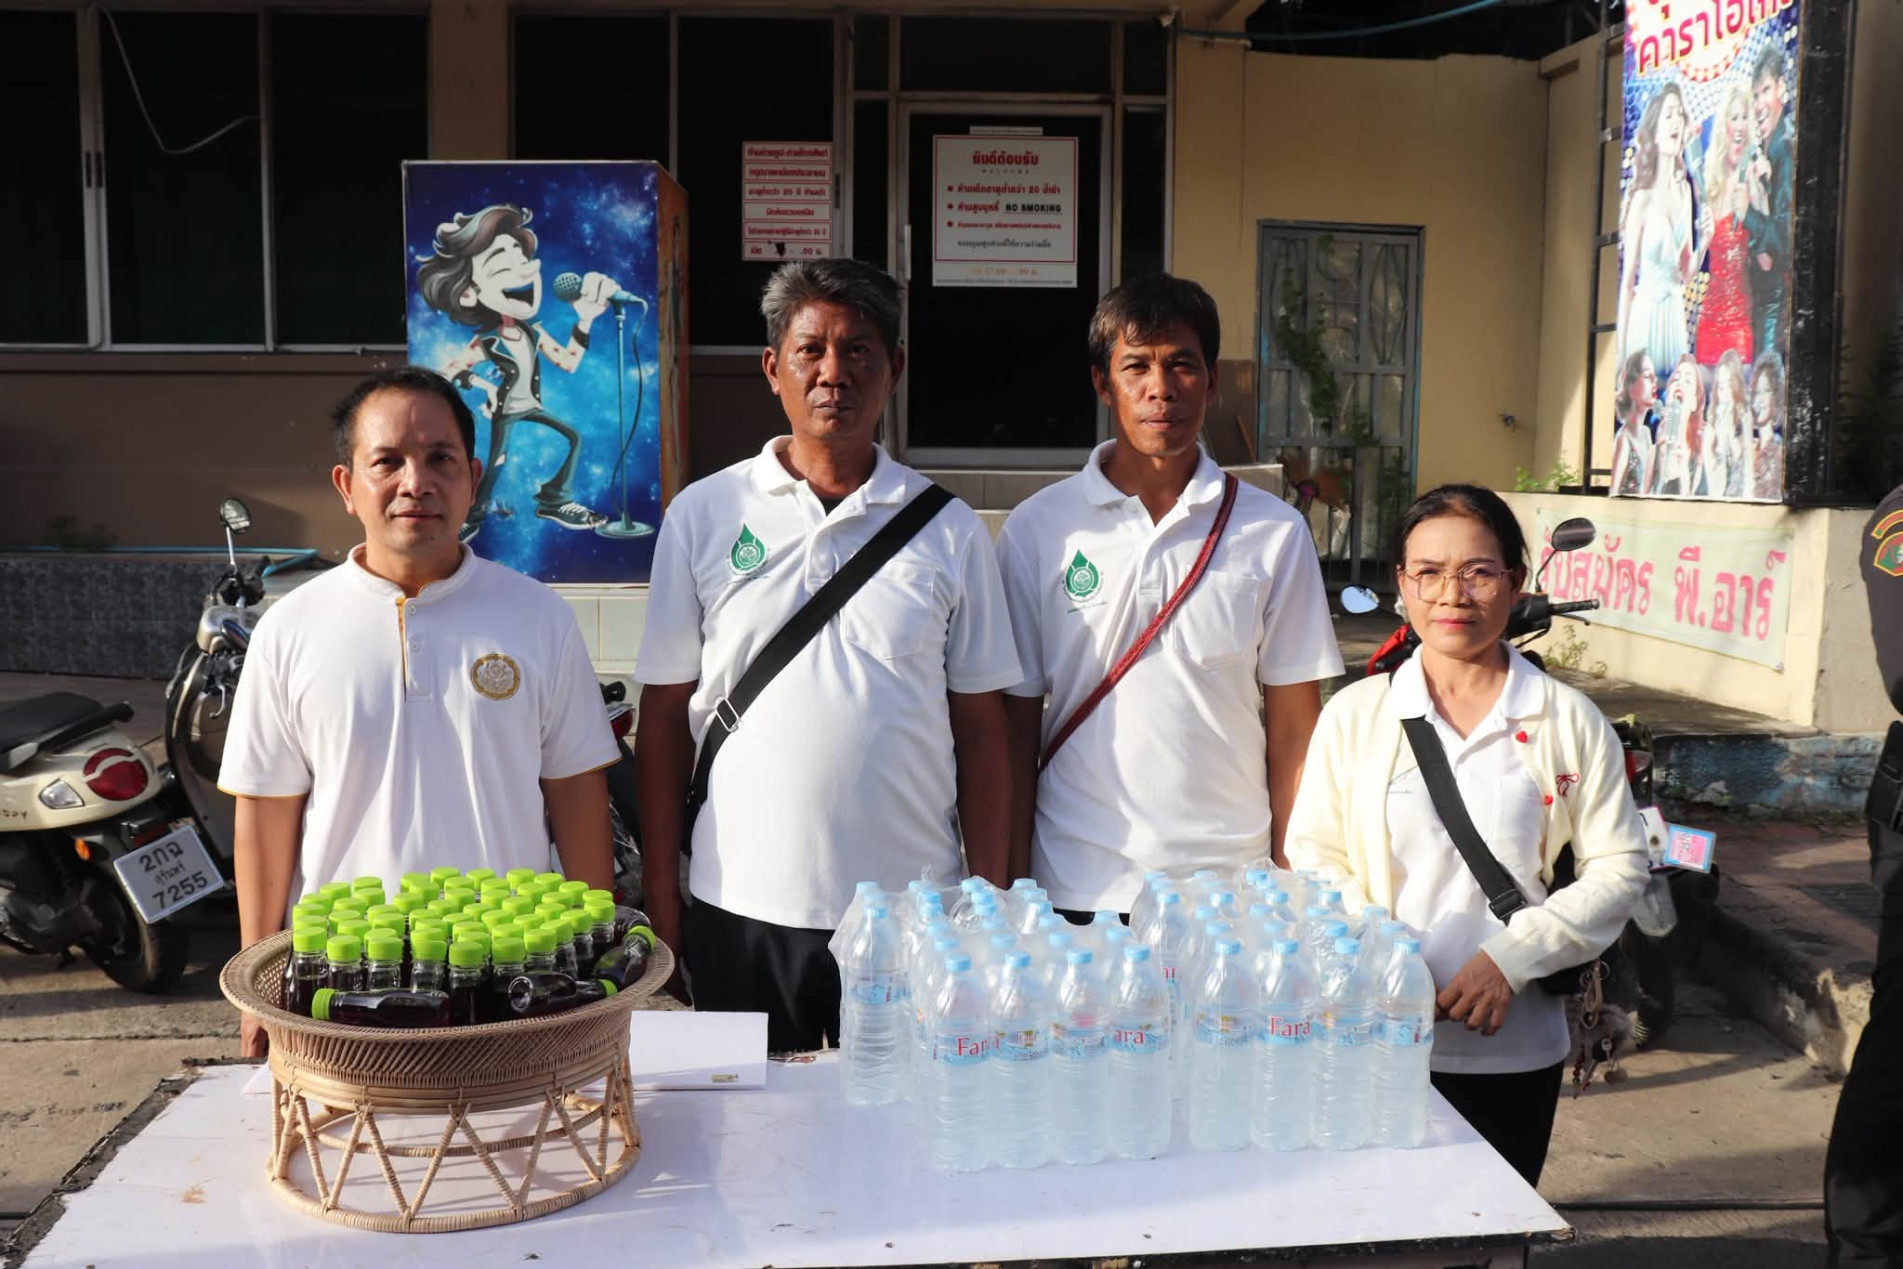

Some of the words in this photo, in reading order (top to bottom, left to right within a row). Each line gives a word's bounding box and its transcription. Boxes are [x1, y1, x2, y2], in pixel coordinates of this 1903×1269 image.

[1639, 0, 1791, 74] คาราโอเ
[973, 150, 1039, 165] ยินดีต้อนรับ
[1028, 186, 1040, 194] 20
[1005, 203, 1018, 212] NO
[1021, 203, 1062, 213] SMOKING
[1674, 545, 1787, 641] พี.อาร์
[152, 871, 208, 909] 7255
[1269, 1016, 1311, 1037] Fara
[1113, 1029, 1145, 1045] ara
